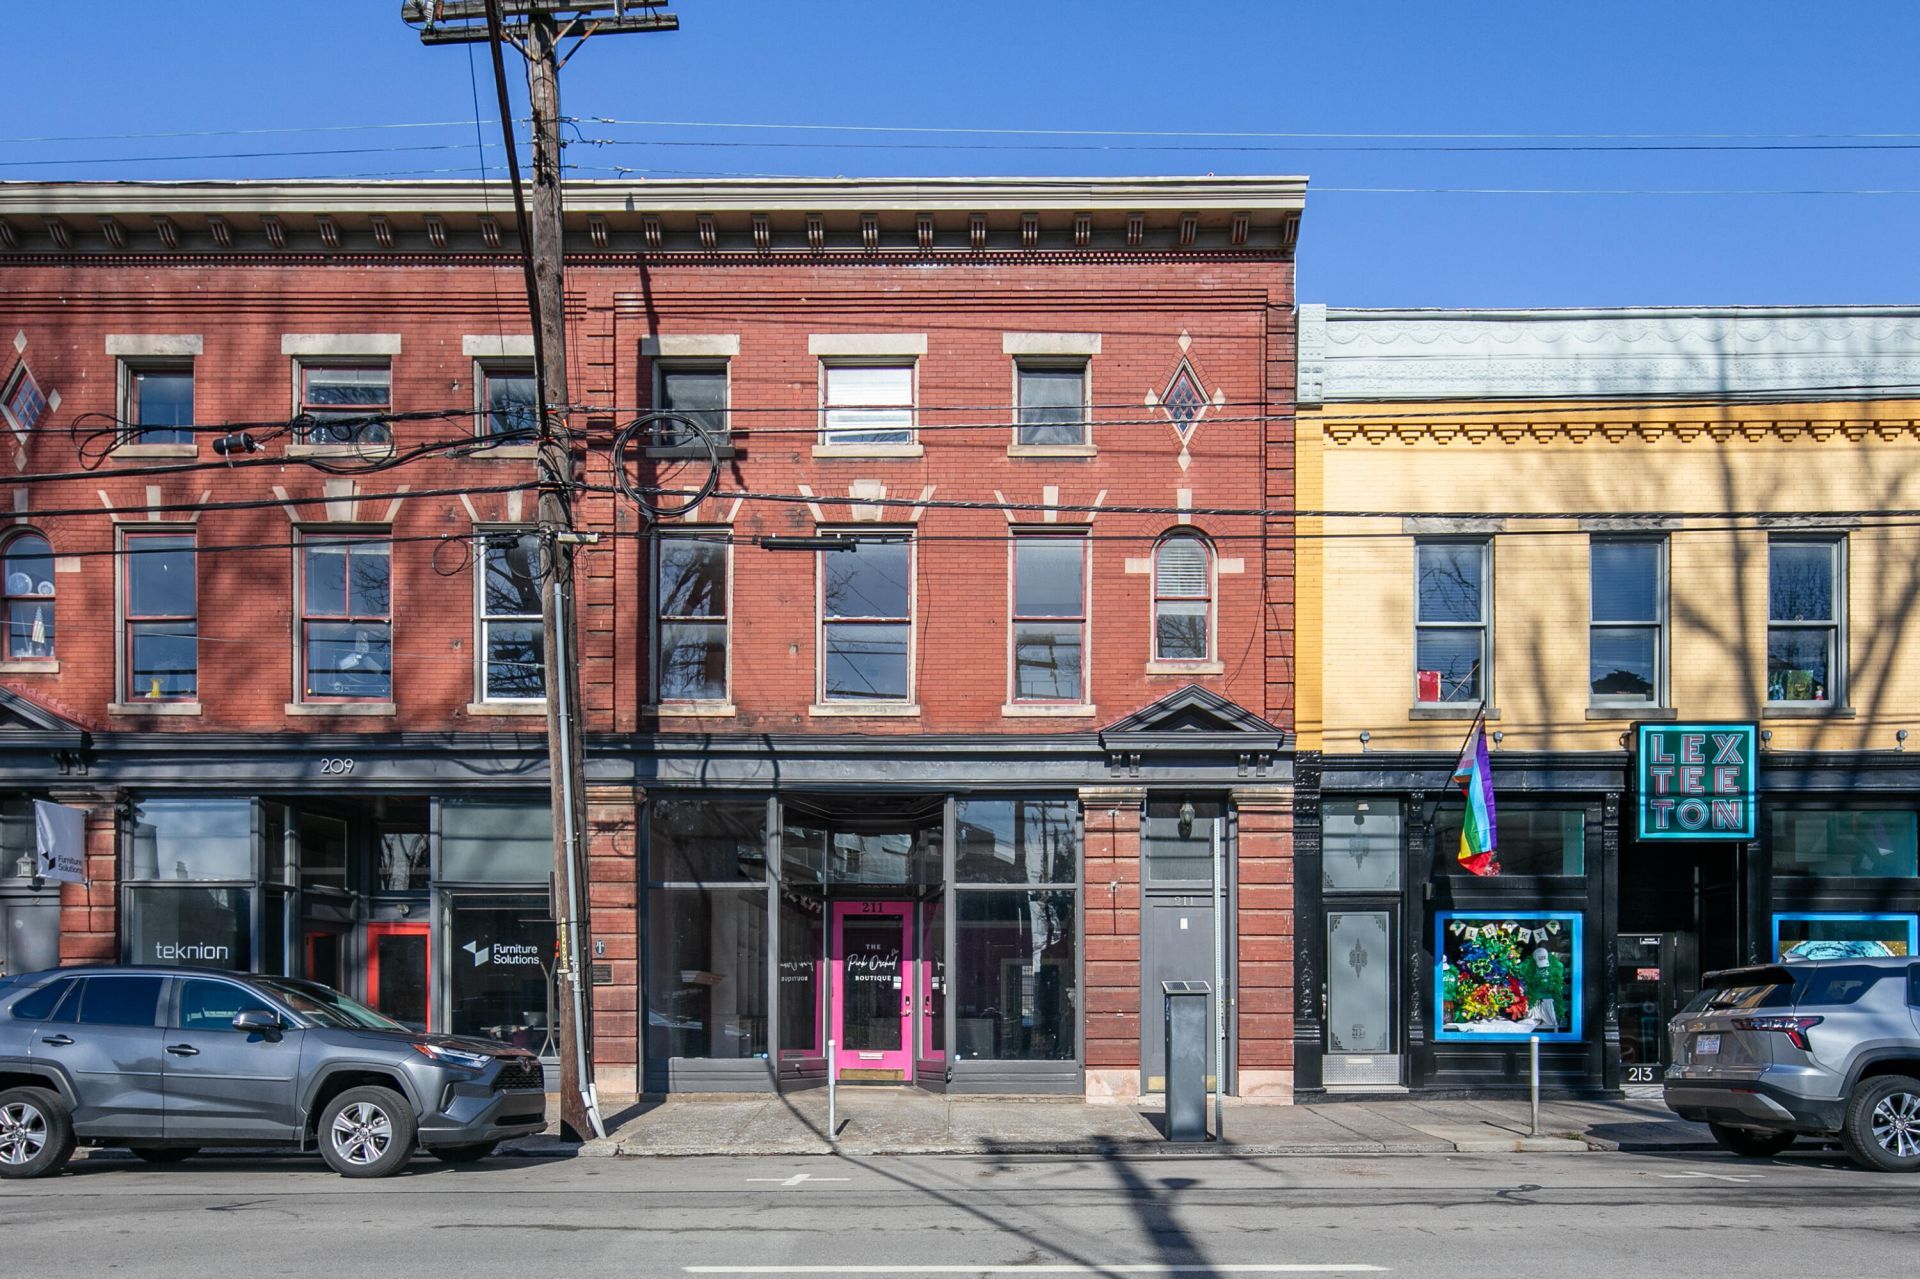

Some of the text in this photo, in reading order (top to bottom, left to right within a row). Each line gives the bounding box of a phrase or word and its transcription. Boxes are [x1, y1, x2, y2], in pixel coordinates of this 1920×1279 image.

[1651, 734, 1744, 764] LEX
[320, 758, 354, 773] 209
[1651, 766, 1740, 796] TEE
[1650, 798, 1743, 830] TON
[862, 902, 883, 913] 211
[1174, 896, 1194, 906] 211
[155, 941, 229, 960] teknion
[493, 943, 538, 954] Furniture
[493, 954, 540, 965] Solutions
[1628, 1067, 1653, 1082] 213
